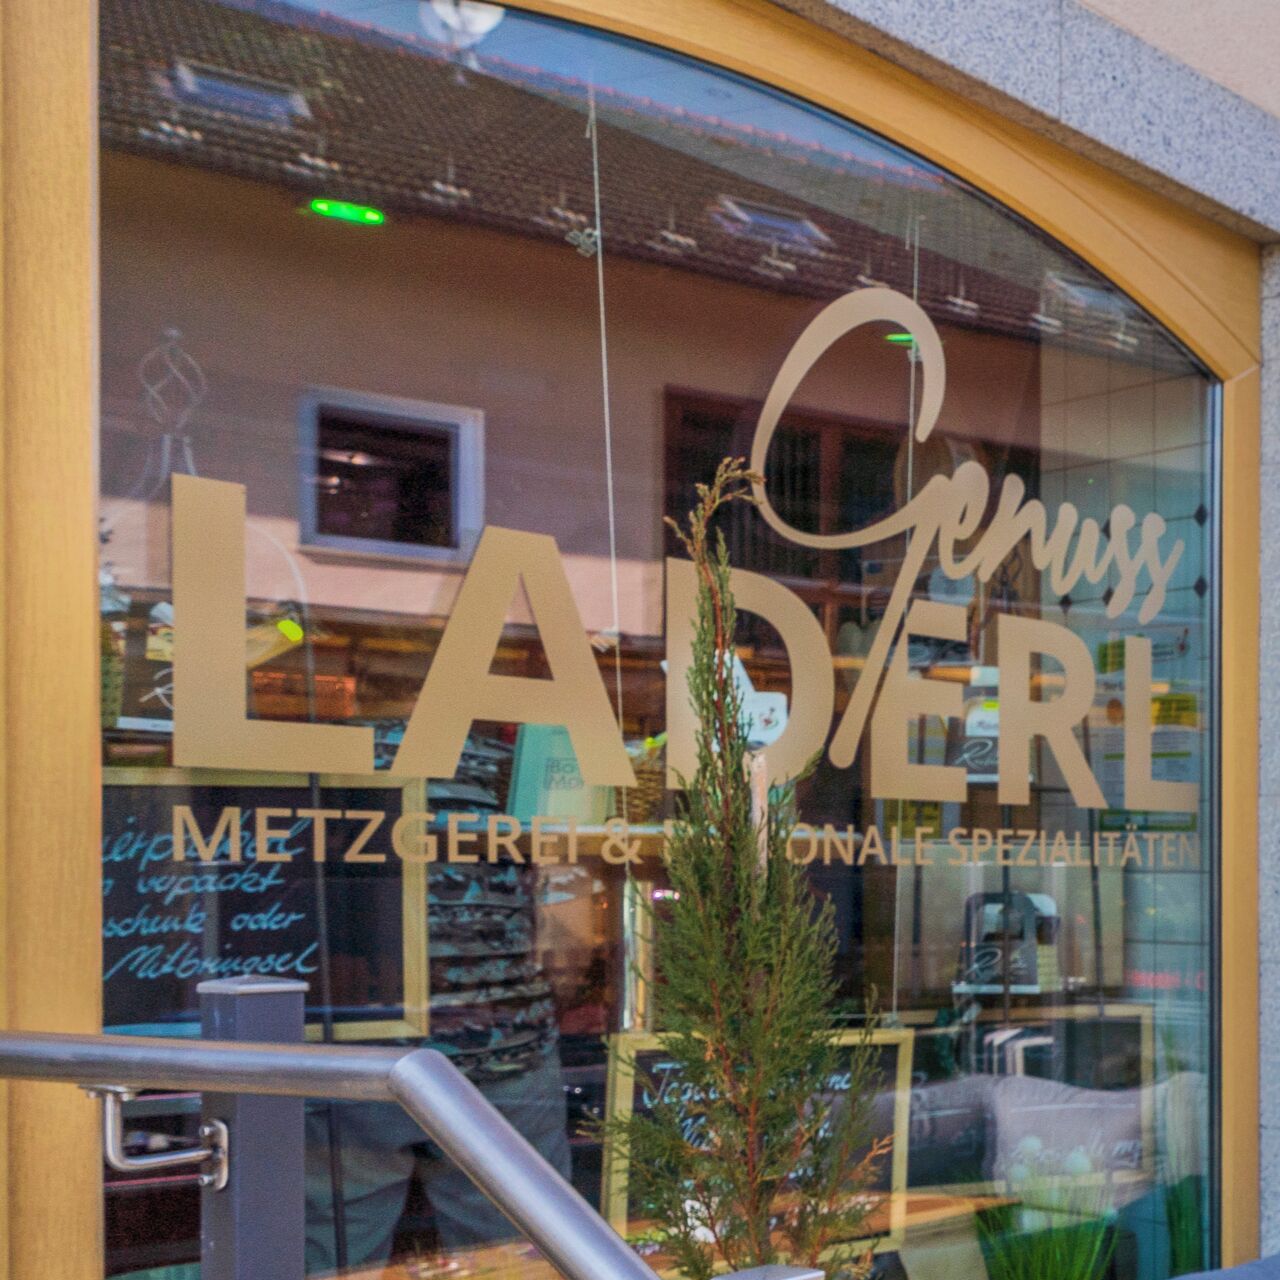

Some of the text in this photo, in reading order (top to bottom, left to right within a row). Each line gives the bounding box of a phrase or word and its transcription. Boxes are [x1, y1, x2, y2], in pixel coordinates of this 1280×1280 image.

[171, 472, 1198, 812] LADERL
[750, 286, 1185, 769] Genuss
[171, 804, 578, 864] METZGEREI
[601, 816, 643, 865] &
[948, 823, 1198, 869] SPEZIALITÄTEN
